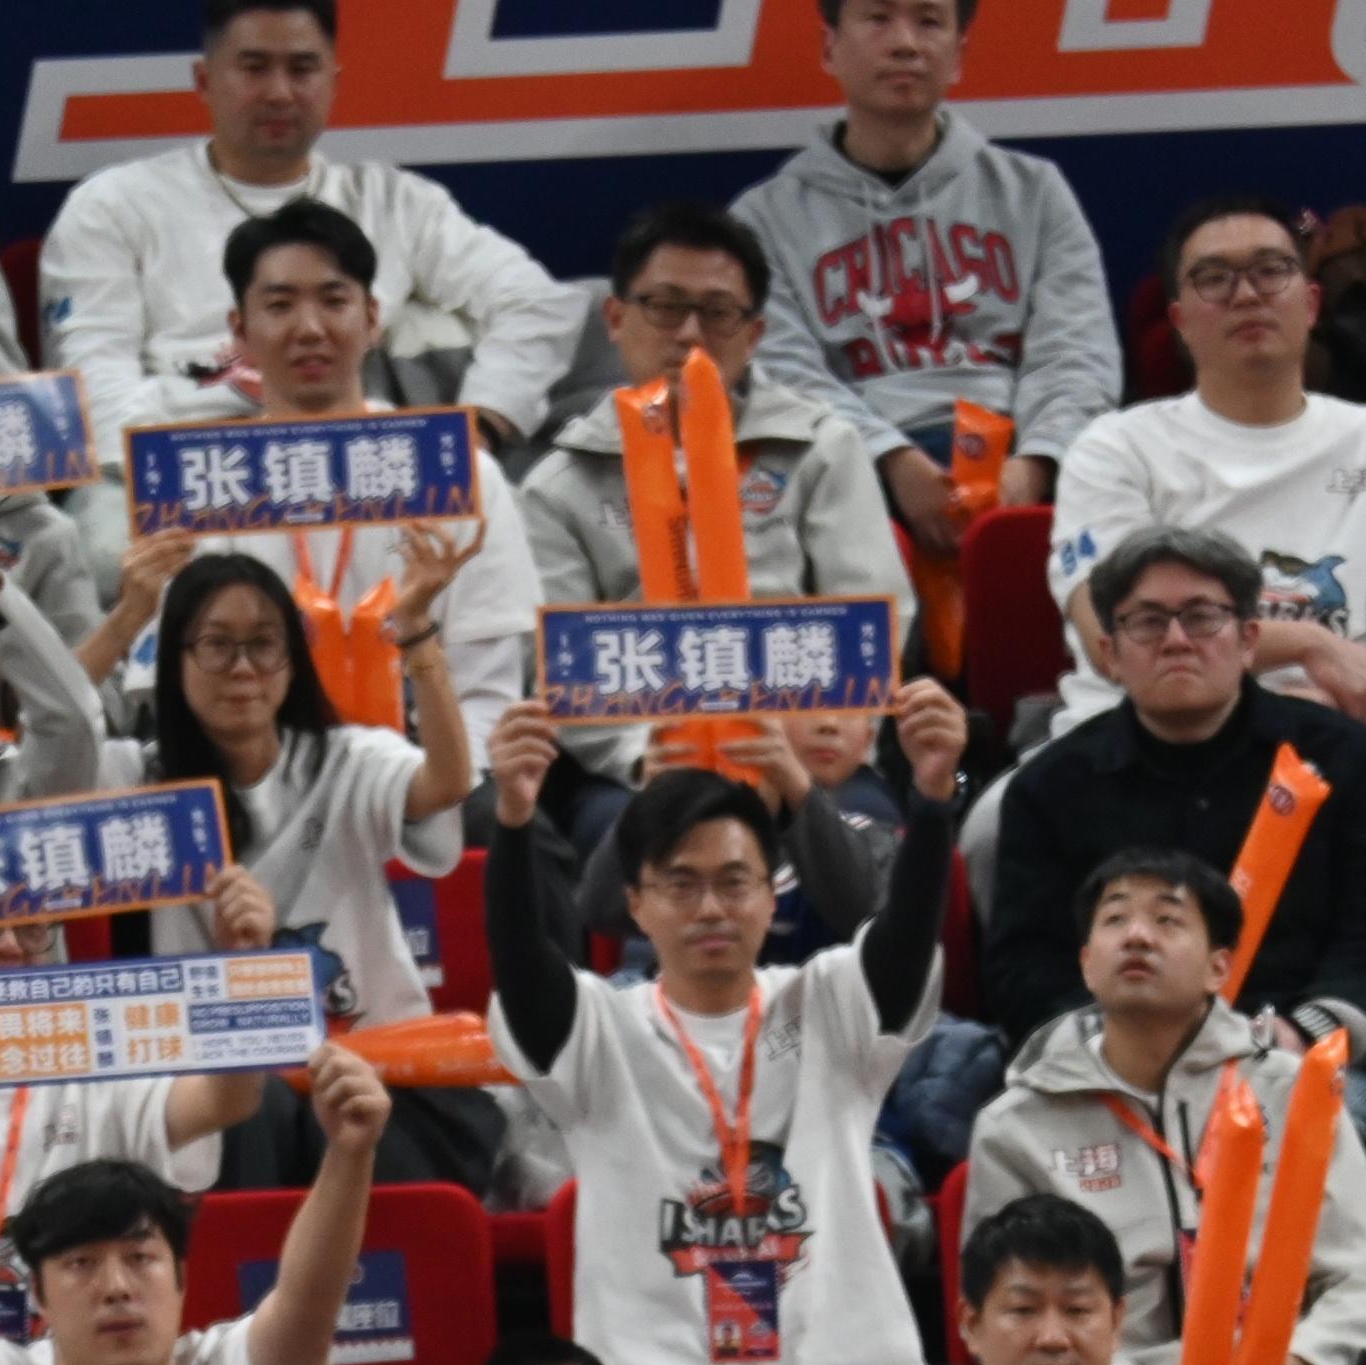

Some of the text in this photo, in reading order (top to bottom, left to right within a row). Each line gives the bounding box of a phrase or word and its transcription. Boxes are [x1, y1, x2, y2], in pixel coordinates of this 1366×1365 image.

[181, 434, 418, 511] 张镇麟
[592, 621, 837, 695] 张镇麟
